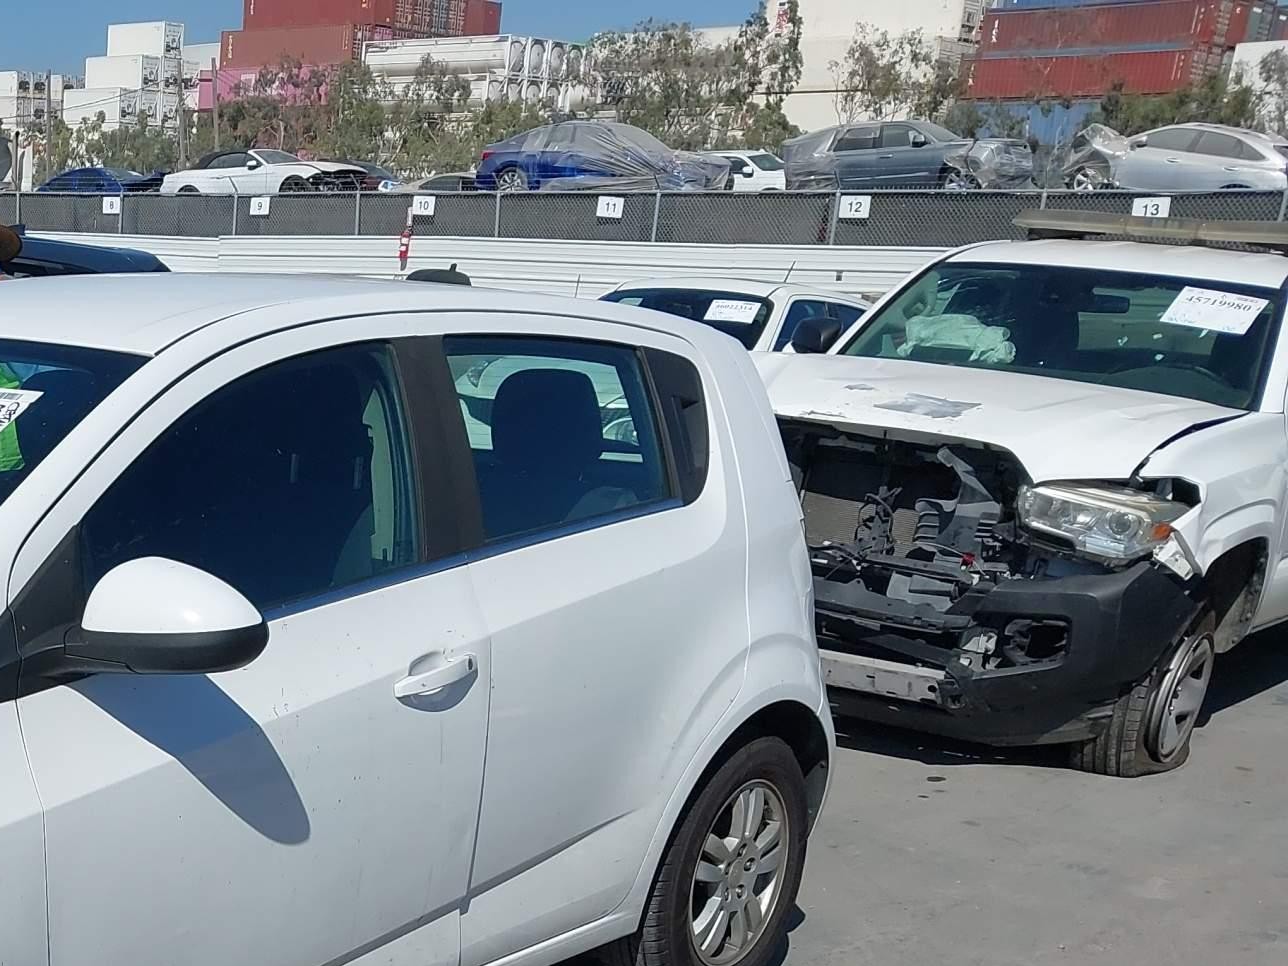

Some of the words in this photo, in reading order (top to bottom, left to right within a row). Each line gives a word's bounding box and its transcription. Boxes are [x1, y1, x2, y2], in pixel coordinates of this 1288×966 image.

[419, 200, 430, 211] 10
[606, 201, 617, 213] 11
[848, 201, 863, 213] 12
[1143, 203, 1160, 217] 13
